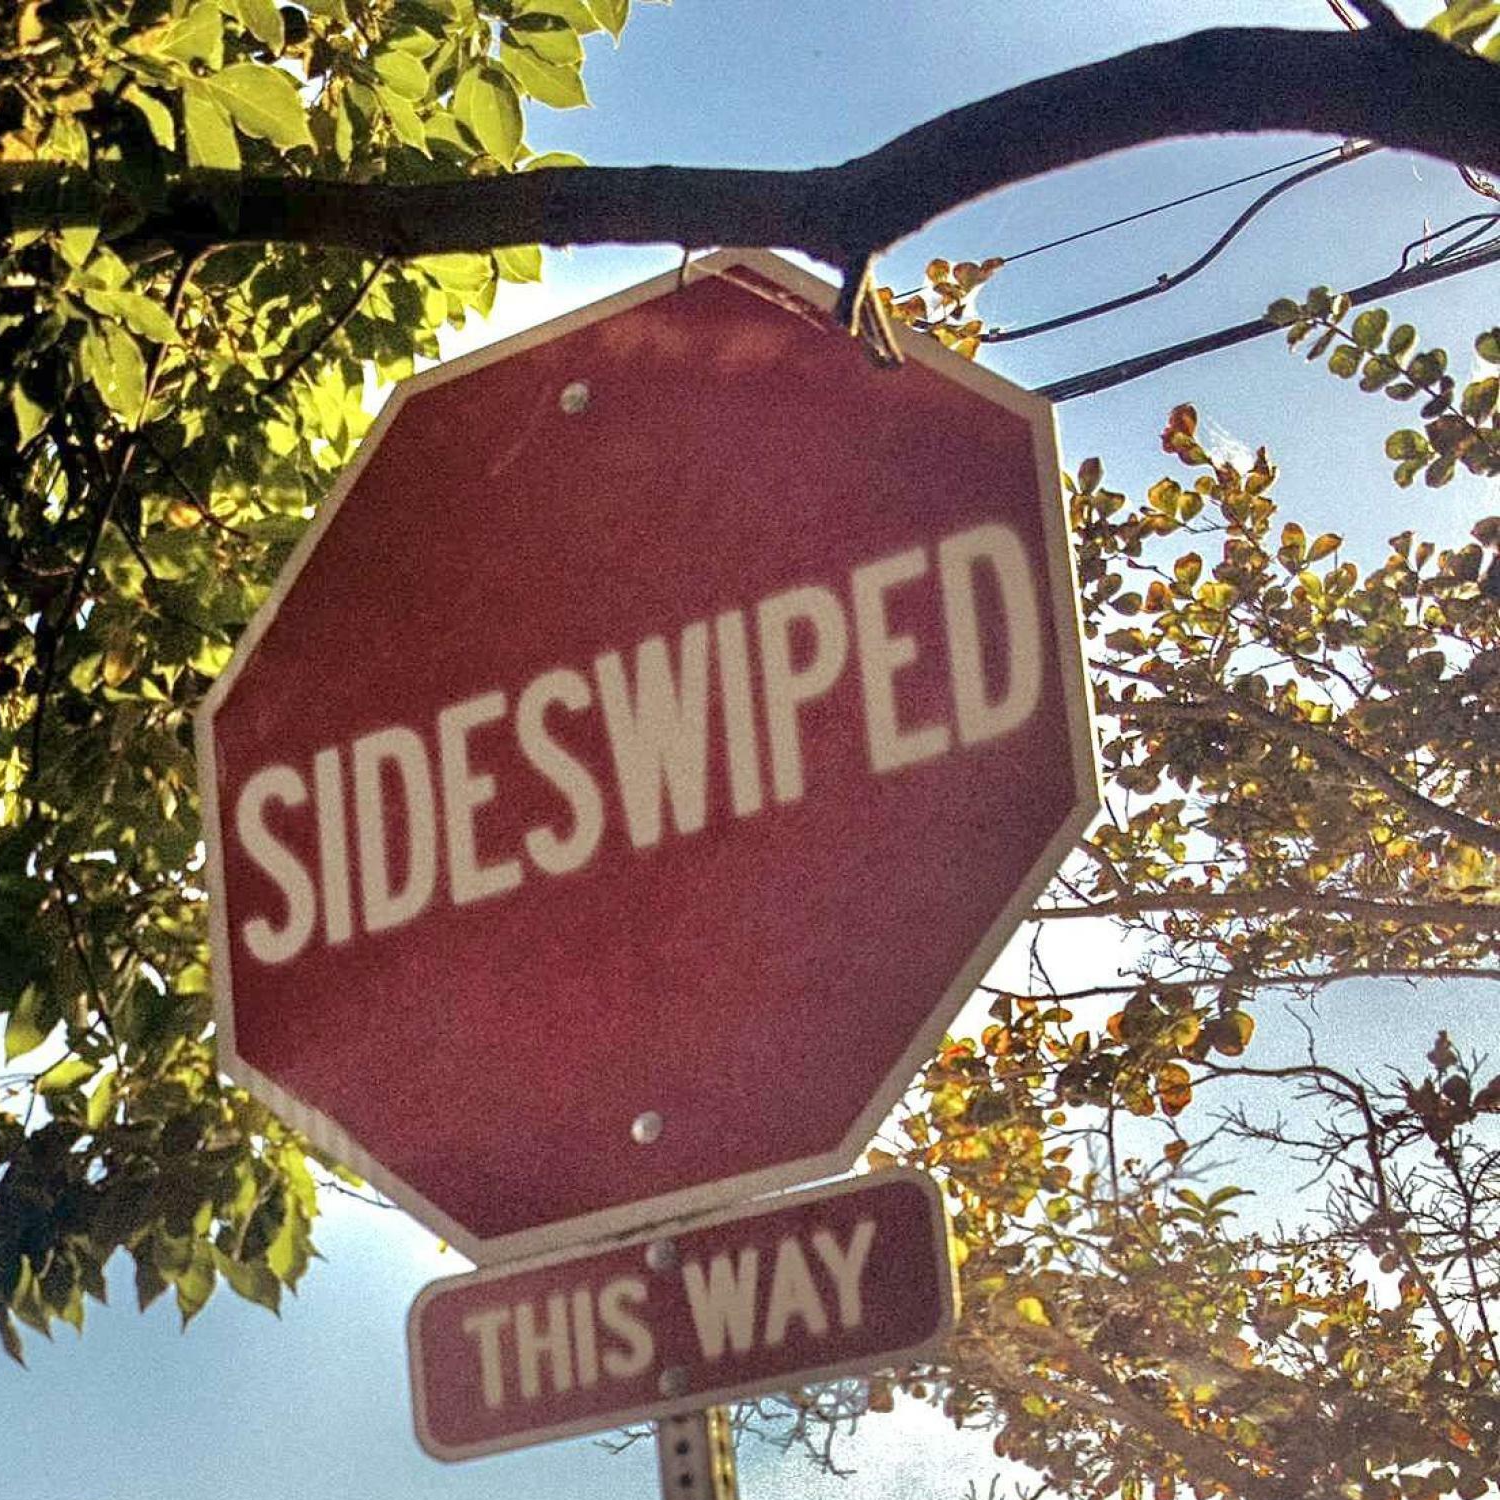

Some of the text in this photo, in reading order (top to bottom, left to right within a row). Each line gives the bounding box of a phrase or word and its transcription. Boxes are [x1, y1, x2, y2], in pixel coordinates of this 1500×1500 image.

[236, 523, 1043, 964] SIDESWIPED
[463, 1220, 876, 1409] THIS WAY
